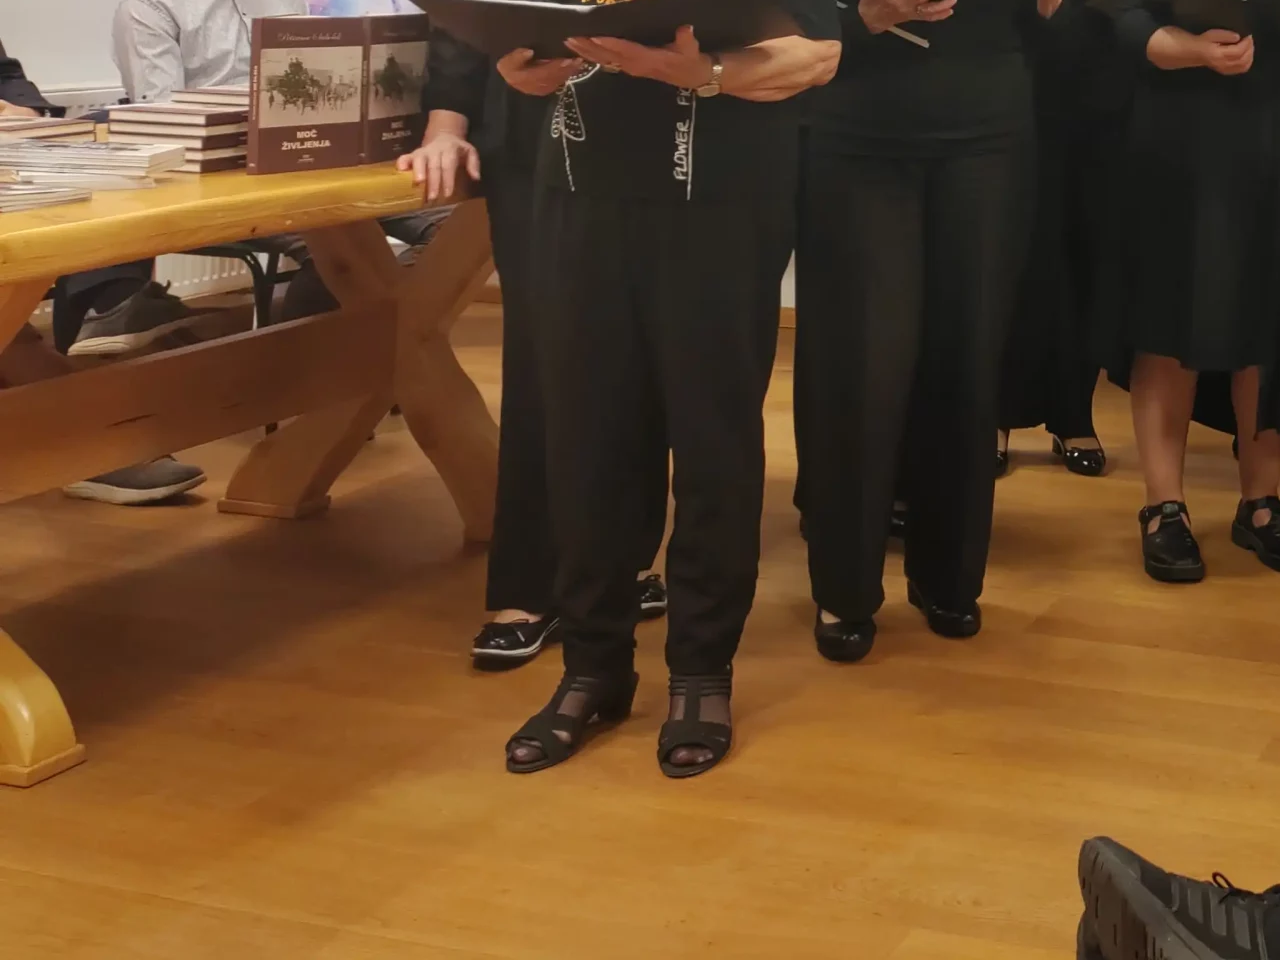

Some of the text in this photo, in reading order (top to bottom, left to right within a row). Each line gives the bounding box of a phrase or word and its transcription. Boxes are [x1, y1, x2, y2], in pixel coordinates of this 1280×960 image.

[296, 129, 318, 139] MOČ
[281, 140, 331, 151] ŽIVLJENJA
[673, 119, 690, 180] FLOWER
